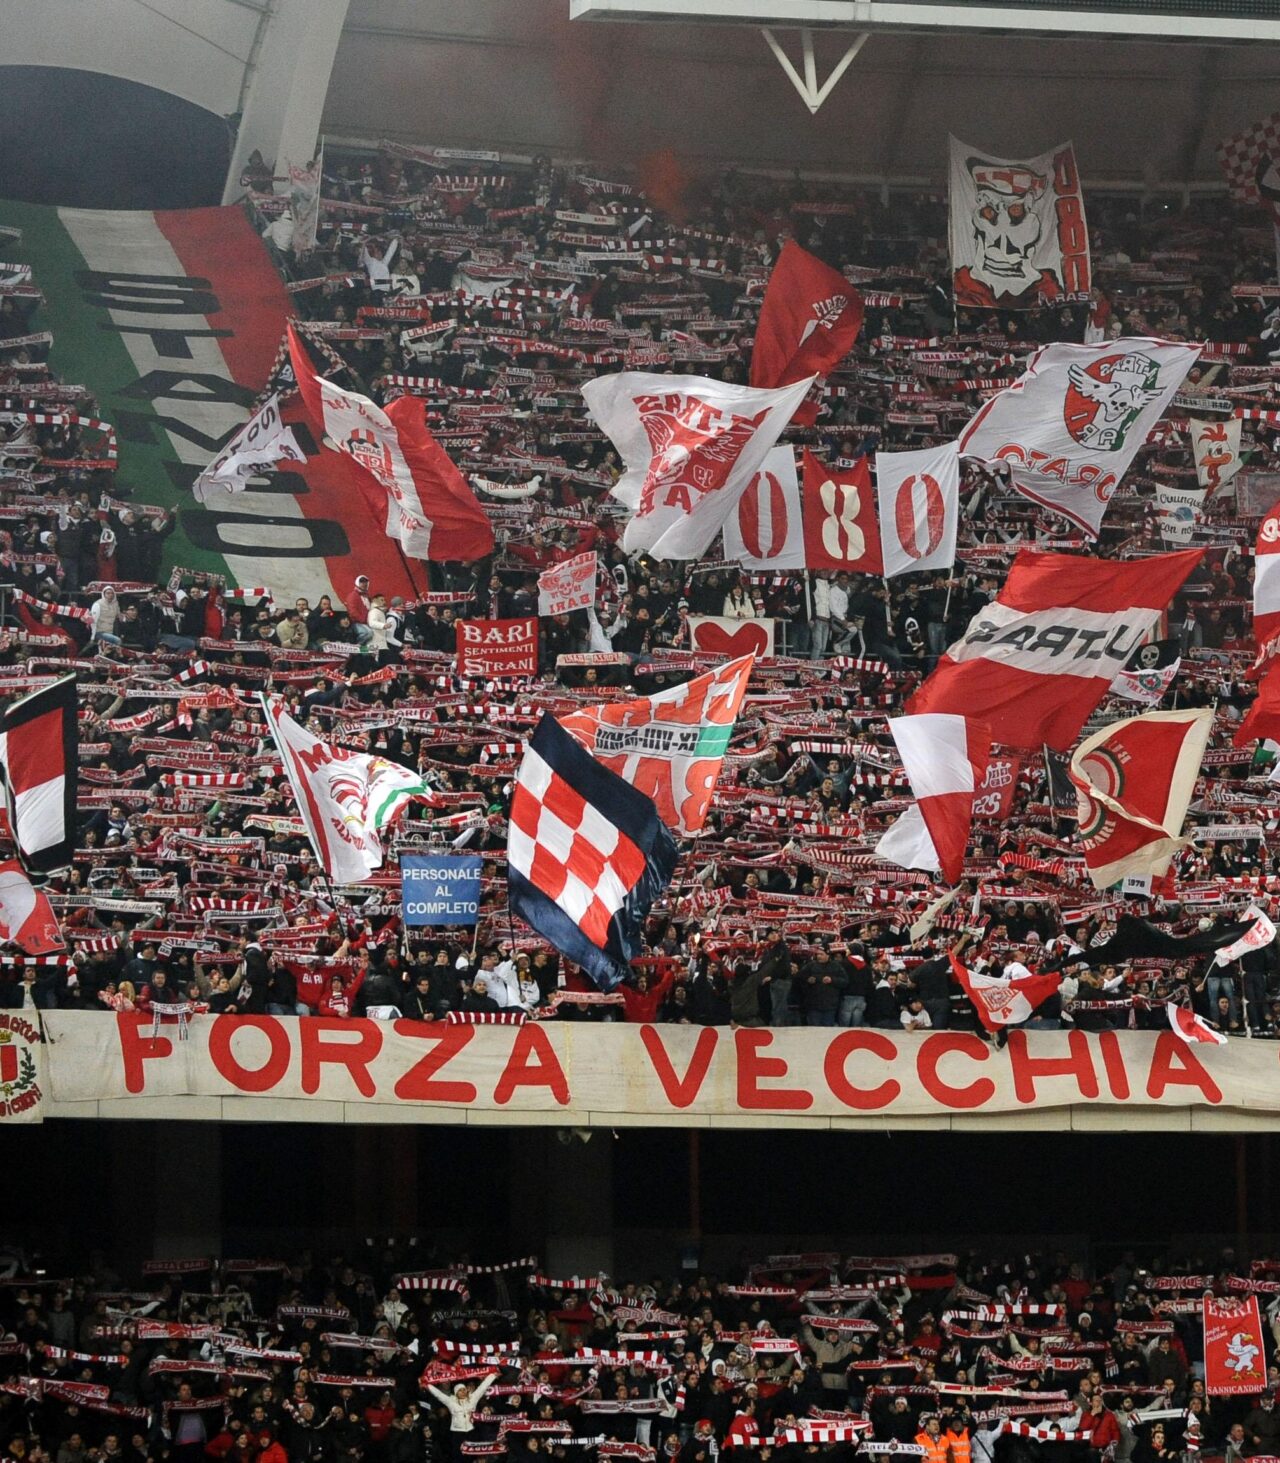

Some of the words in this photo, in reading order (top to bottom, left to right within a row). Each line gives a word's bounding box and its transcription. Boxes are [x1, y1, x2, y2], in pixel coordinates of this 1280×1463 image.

[408, 320, 452, 338] ULTRAS
[464, 620, 535, 644] BARI
[464, 644, 535, 657] SENTIMENTI
[464, 657, 535, 677] STRANI
[402, 868, 482, 881] PERSONALE
[435, 885, 453, 898] AL
[406, 902, 478, 916] COMPLETO
[302, 973, 323, 984] BARI
[117, 1013, 571, 1105] FORZA
[640, 1024, 1222, 1109] VECCHIA
